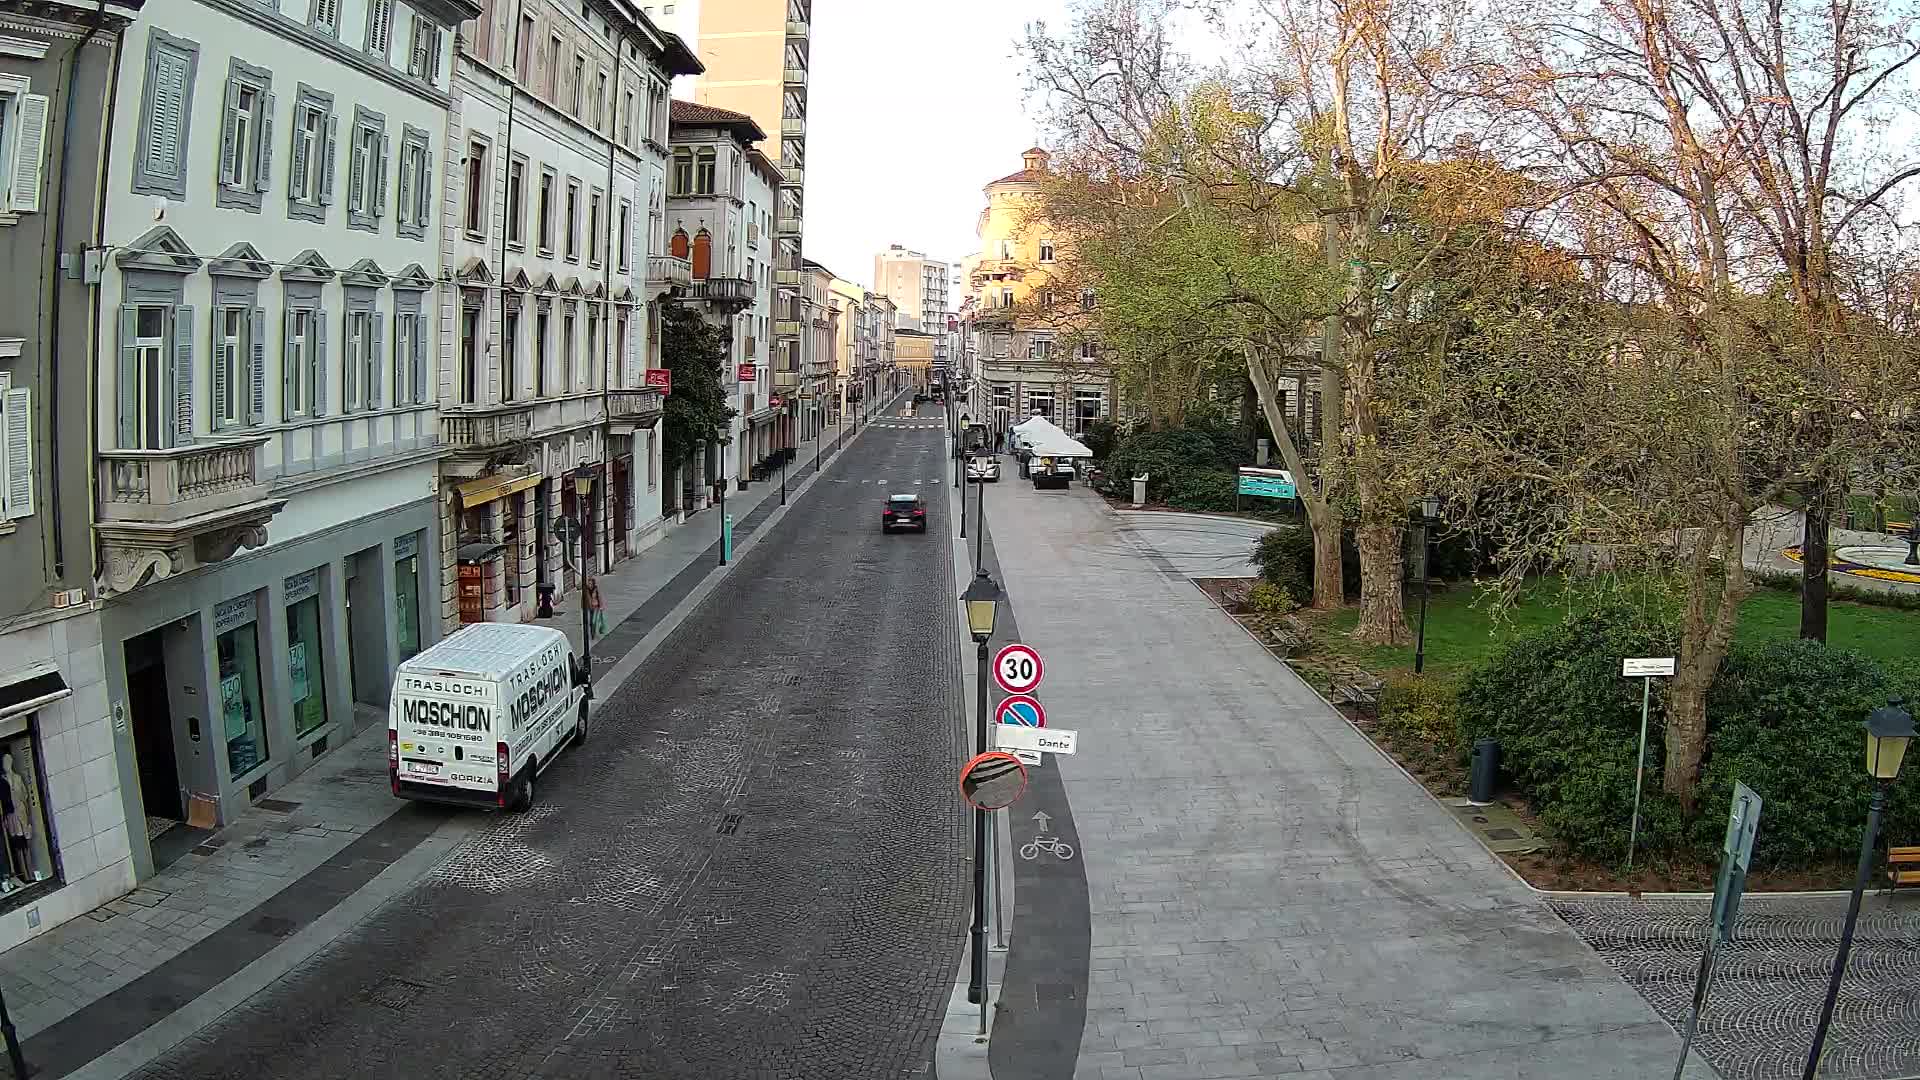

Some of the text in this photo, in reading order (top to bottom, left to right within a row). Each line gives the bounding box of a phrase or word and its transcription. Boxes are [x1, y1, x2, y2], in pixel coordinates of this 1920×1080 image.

[510, 643, 563, 690] TRASLOCHI
[1005, 658, 1033, 680] 30
[405, 678, 488, 696] TRASLOCHI
[510, 660, 567, 731] MOSCHION
[404, 699, 490, 732] MOSCHION
[1038, 738, 1070, 749] Dante
[450, 774, 494, 785] GORIZIA
